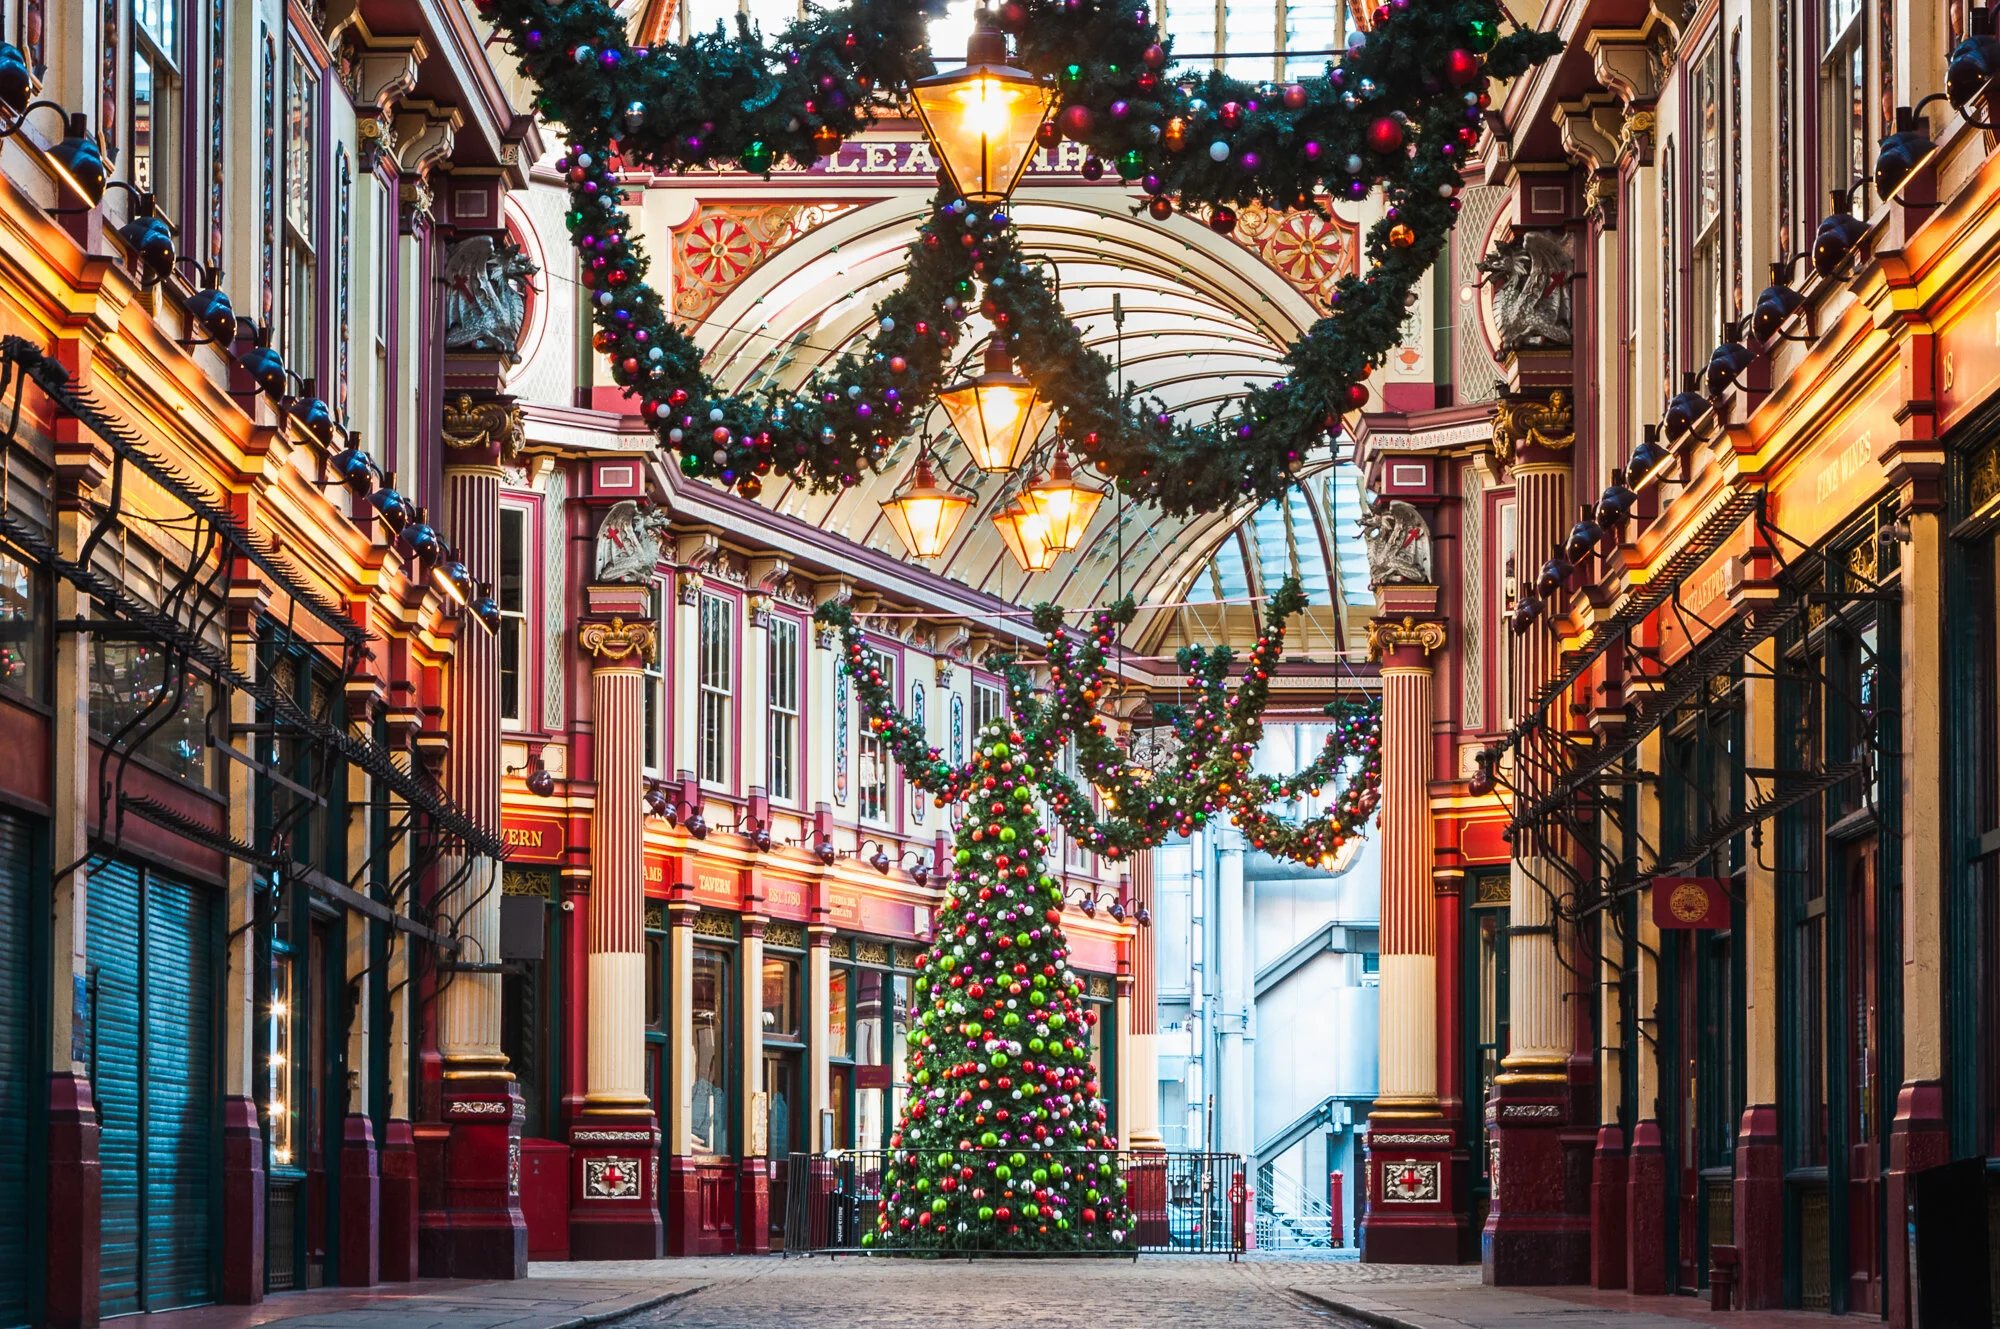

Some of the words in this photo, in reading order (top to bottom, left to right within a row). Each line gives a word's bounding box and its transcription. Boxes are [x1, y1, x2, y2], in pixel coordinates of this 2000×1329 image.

[1943, 351, 1953, 392] 18
[1816, 458, 1839, 505] FINE
[1840, 429, 1871, 485] WINES
[699, 874, 731, 895] TAVERN
